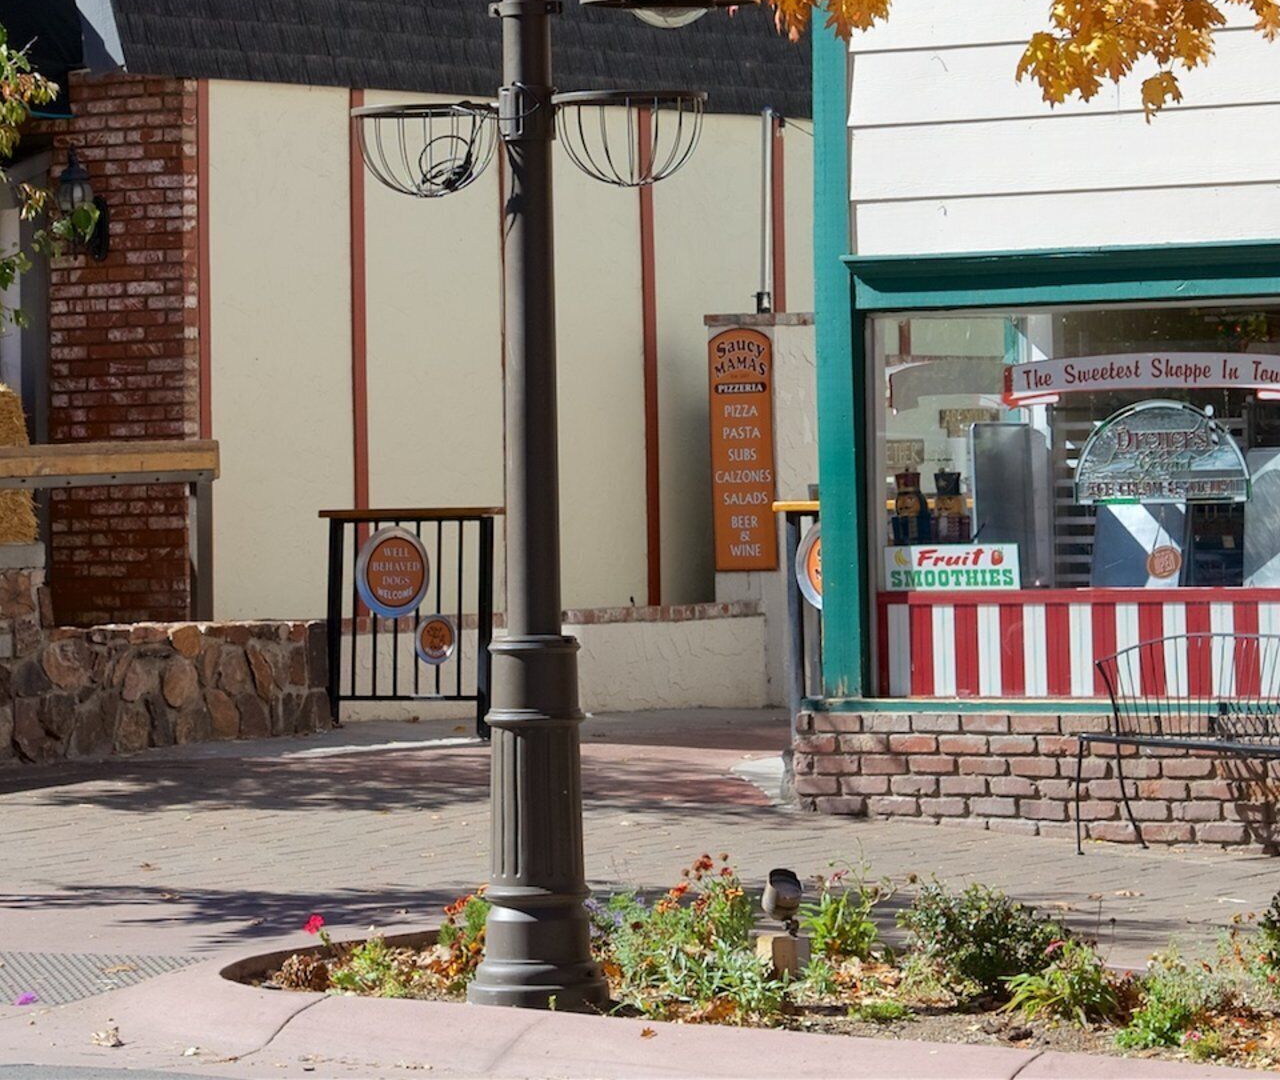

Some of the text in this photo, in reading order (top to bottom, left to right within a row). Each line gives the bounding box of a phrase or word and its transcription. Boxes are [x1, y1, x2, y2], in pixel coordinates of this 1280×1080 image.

[716, 340, 765, 359] Saucy
[1023, 369, 1053, 390] The
[1064, 363, 1141, 384] Sweetest
[1151, 358, 1211, 383] Shoppe
[1222, 359, 1239, 380] In
[717, 383, 763, 393] PIZZERIA
[724, 404, 758, 417] PIZZA
[723, 426, 761, 439] PASTA
[728, 448, 757, 461] SUBS
[715, 469, 771, 483] CALZONES
[723, 492, 768, 505] SALADS
[731, 515, 758, 528] BEER
[740, 531, 751, 541] &
[384, 547, 409, 557] WELL
[729, 544, 761, 556] WINE
[917, 548, 984, 567] Fruit
[373, 561, 422, 572] BEHAVED
[382, 575, 410, 586] DOGS
[891, 569, 1014, 588] SMOOTHIES
[377, 586, 413, 599] WELCOME
